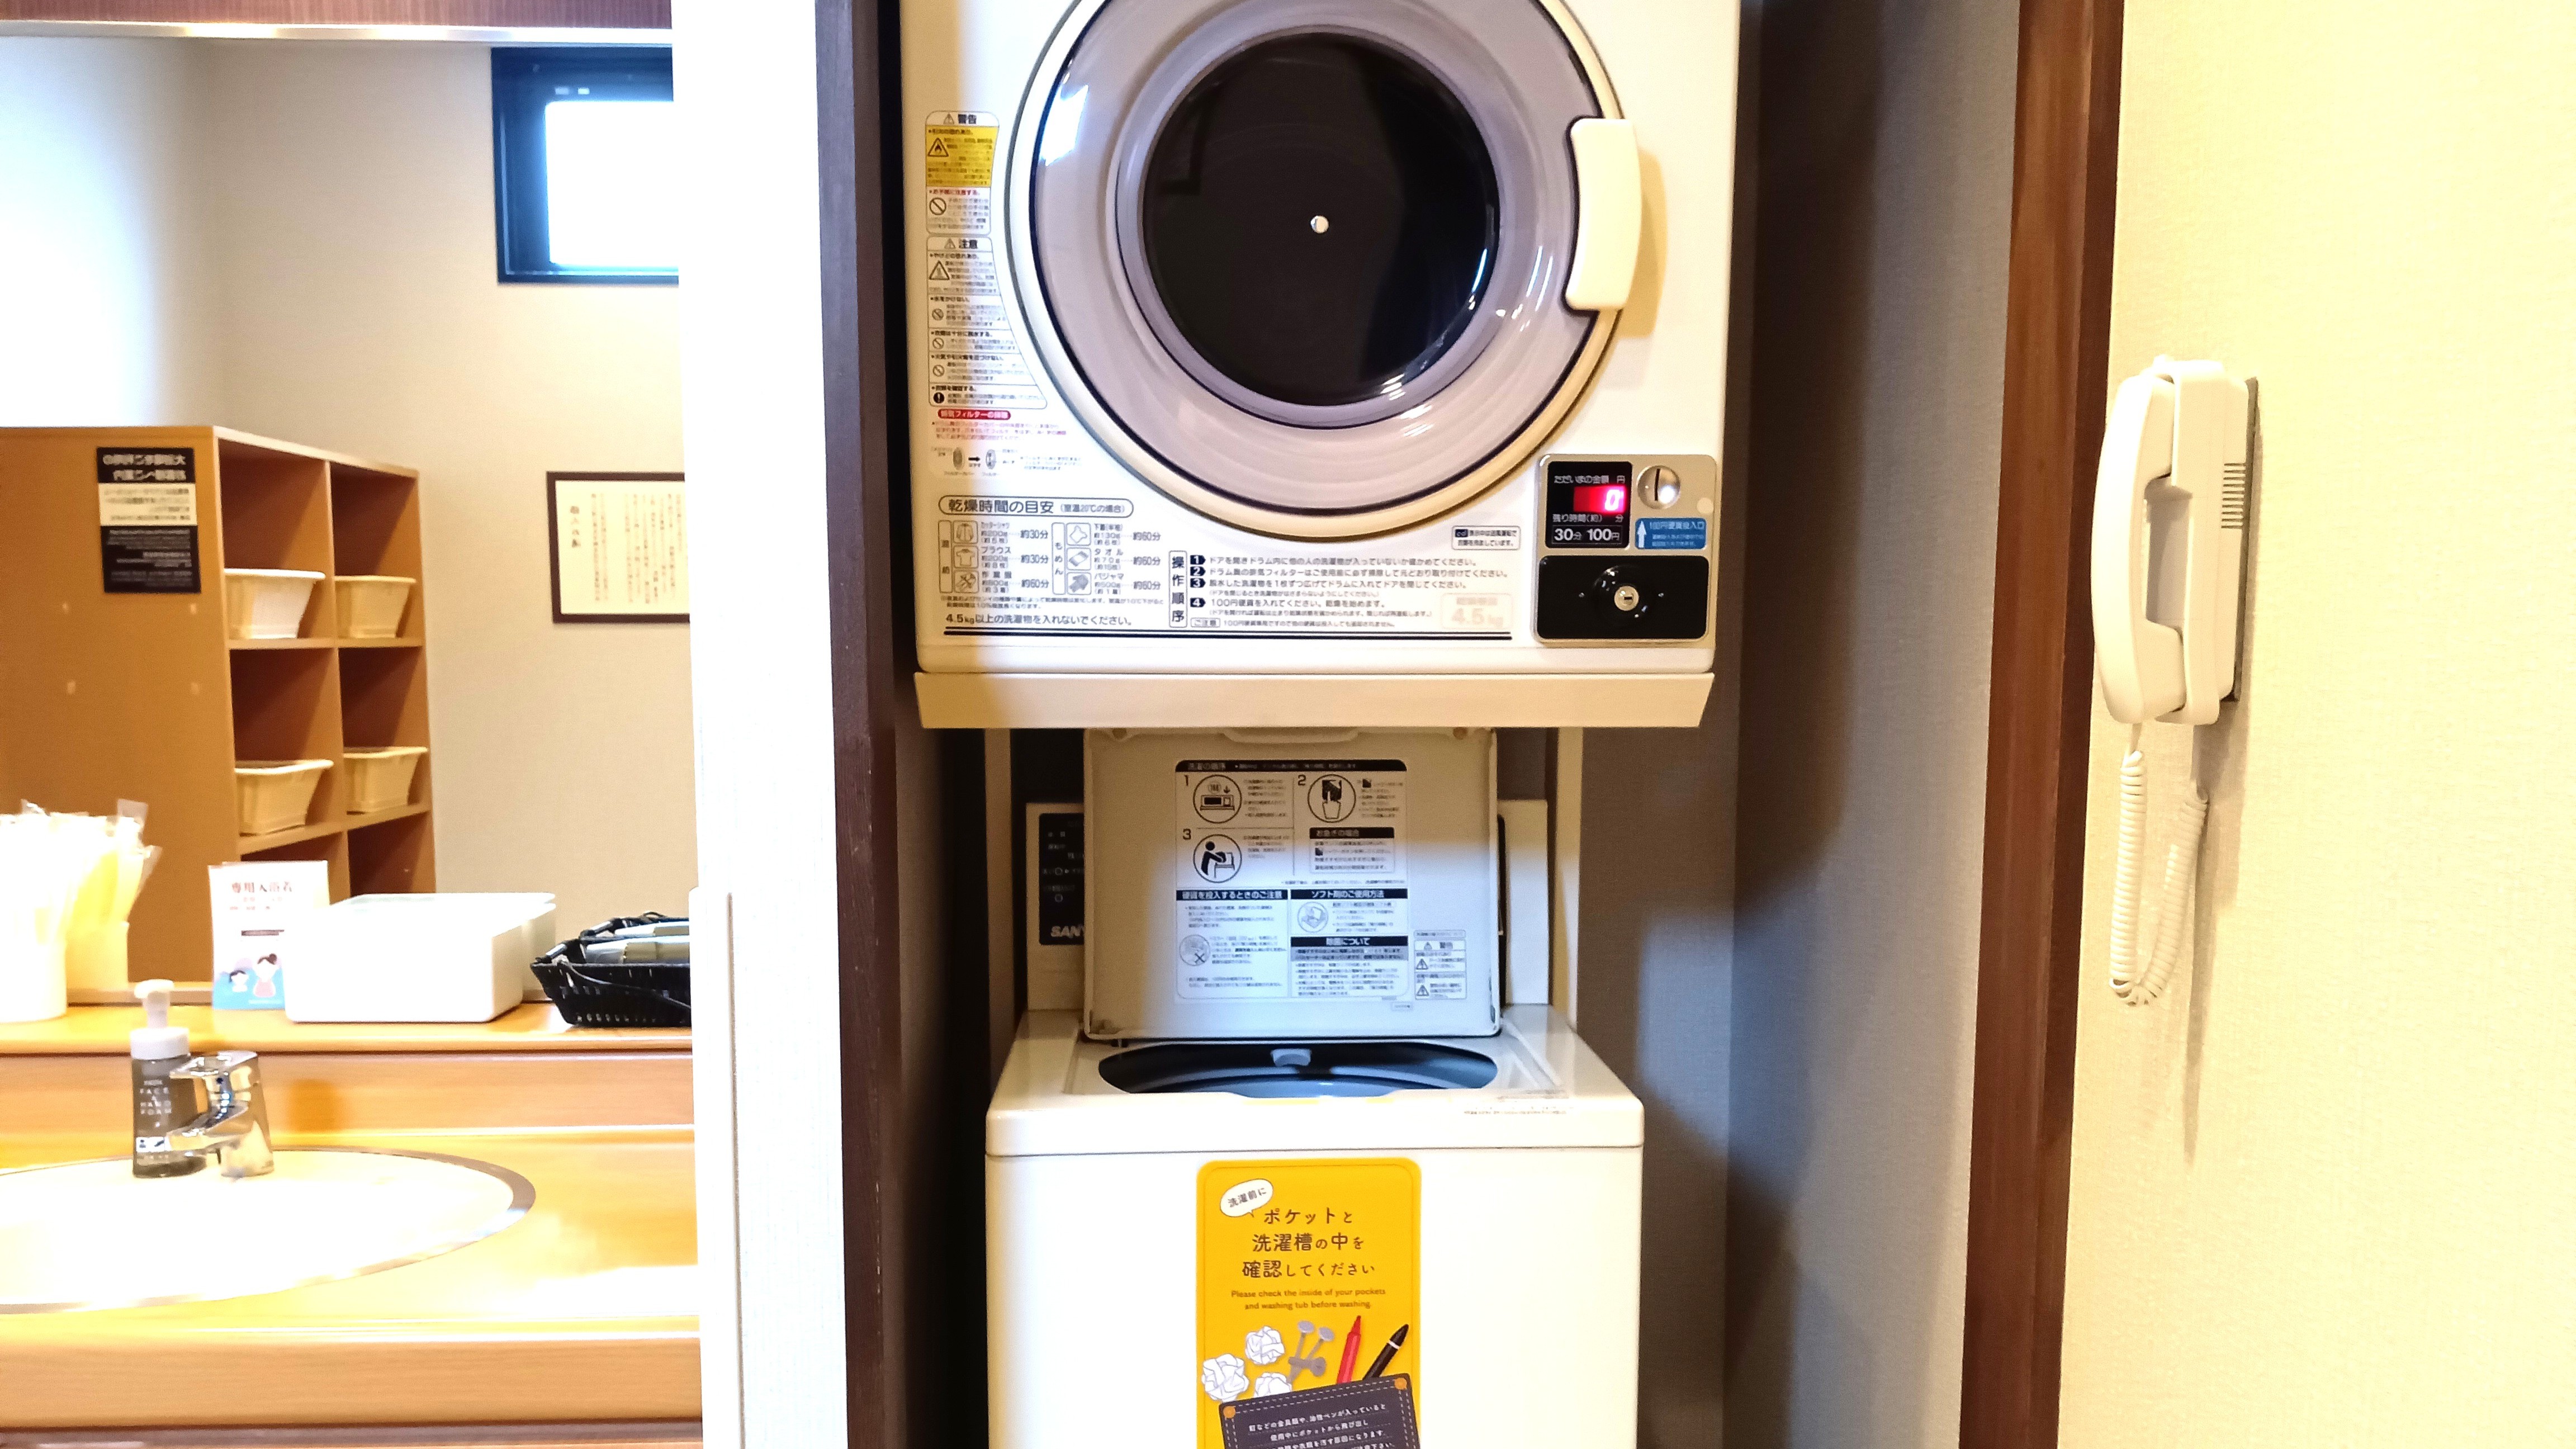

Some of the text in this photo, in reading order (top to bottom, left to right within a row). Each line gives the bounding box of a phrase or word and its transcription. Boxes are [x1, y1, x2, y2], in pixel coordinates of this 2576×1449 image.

[959, 239, 978, 249] 注意
[1554, 475, 1609, 484] ただいまの金額
[949, 499, 1054, 514] 乾燥時間の目安
[1604, 490, 1621, 511] 0
[1020, 529, 1048, 539] 約30分
[1554, 528, 1620, 541] 30分 100円
[1021, 554, 1049, 564] 約30分
[1055, 542, 1063, 575] もめん
[1172, 556, 1185, 623] 操作順序
[1192, 598, 1201, 607] 4
[945, 614, 1132, 626] 4.5kg以上の洗濯物を入れないでください。
[1184, 775, 1189, 786] 1
[1298, 775, 1306, 785] 2
[1183, 828, 1191, 840] 3
[1228, 1187, 1267, 1208] 洗濯前に
[1264, 1208, 1353, 1225] ポケットと
[1252, 1233, 1364, 1252] 洗濯槽の中を
[1242, 1260, 1375, 1278] 確認してください
[1262, 1301, 1293, 1311] washing
